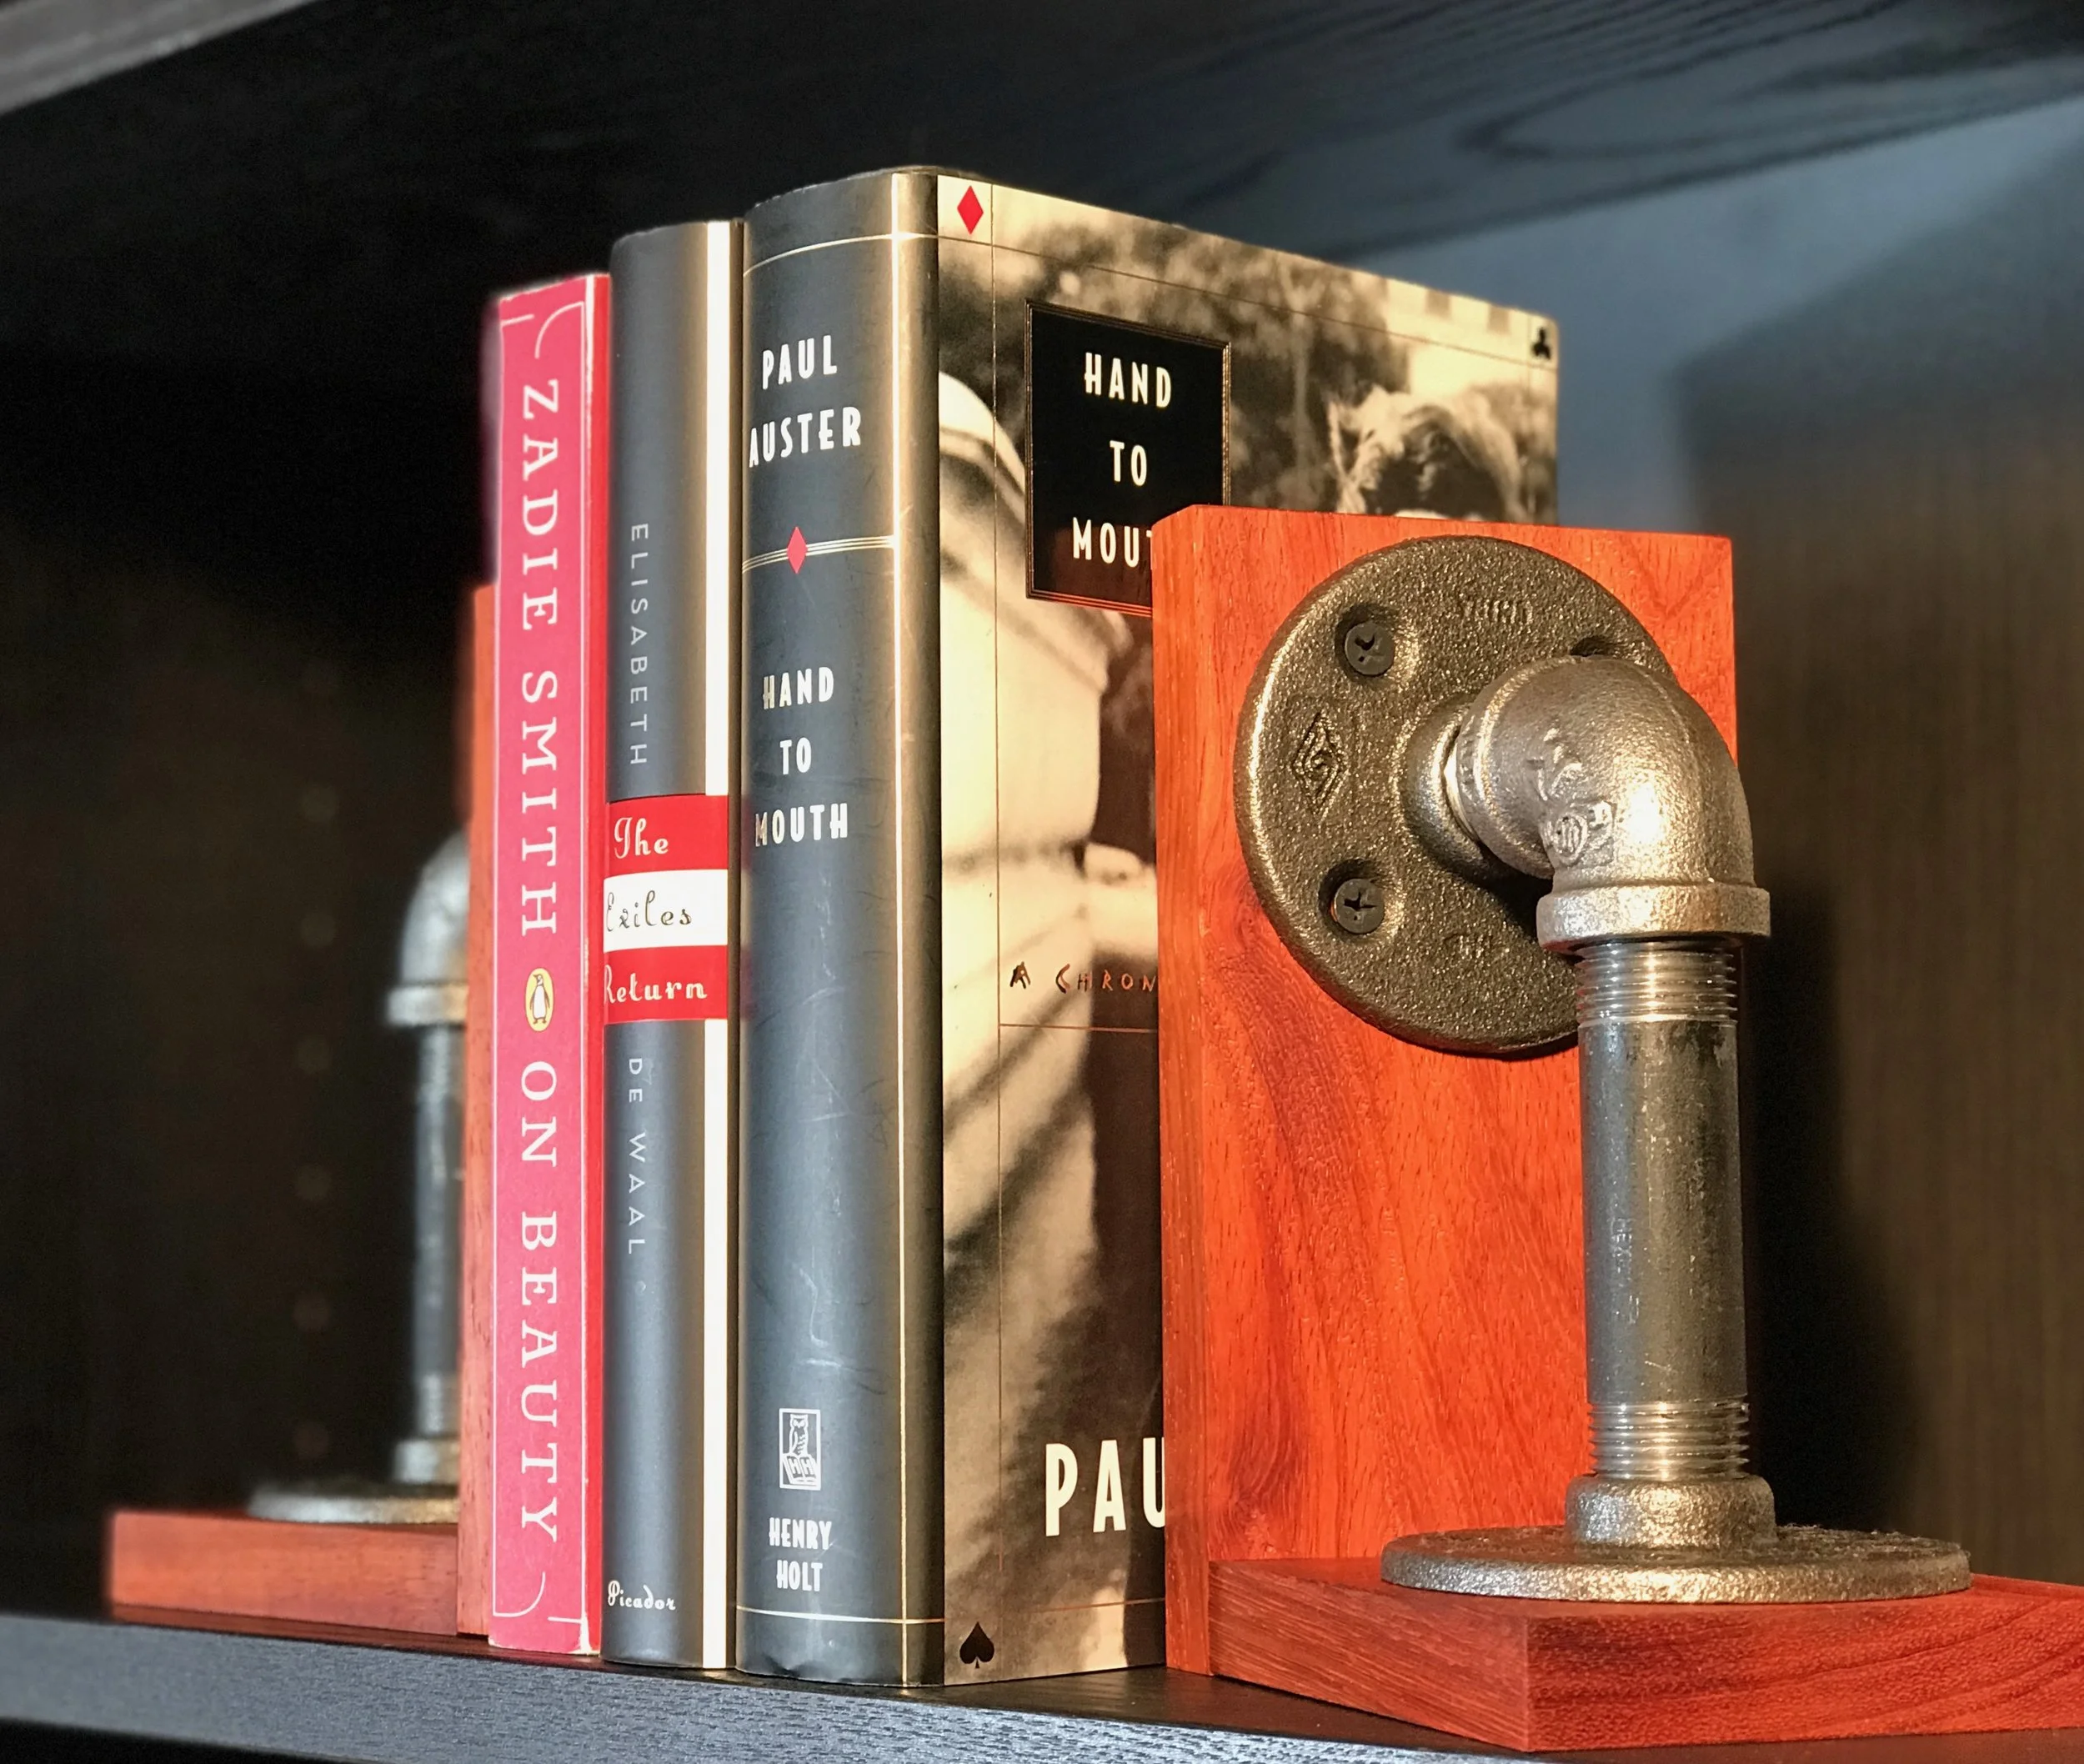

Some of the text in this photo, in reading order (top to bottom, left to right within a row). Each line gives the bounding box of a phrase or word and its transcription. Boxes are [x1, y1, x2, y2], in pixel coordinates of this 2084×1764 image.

[762, 335, 837, 389] PAUL
[1084, 352, 1171, 408] HAND
[749, 406, 861, 468] AUSTER
[1110, 440, 1147, 486] TO
[1073, 517, 1153, 568] MOU
[521, 379, 559, 936] ZADIE SMITH
[630, 523, 649, 765] ELISABETH
[763, 667, 834, 709] HAND
[779, 737, 812, 774] TO
[614, 817, 669, 859] The
[755, 803, 848, 847] MOUTH
[606, 890, 692, 932] Exiles
[604, 965, 707, 1004] Return
[1009, 961, 1030, 990] A
[629, 1058, 646, 1254] DE WAAL
[521, 1062, 558, 1542] ON BEAUTY
[1045, 1437, 1165, 1536] PAU
[769, 1517, 832, 1550] HENRY
[608, 1580, 676, 1611] Picador
[777, 1560, 823, 1592] HOLT
